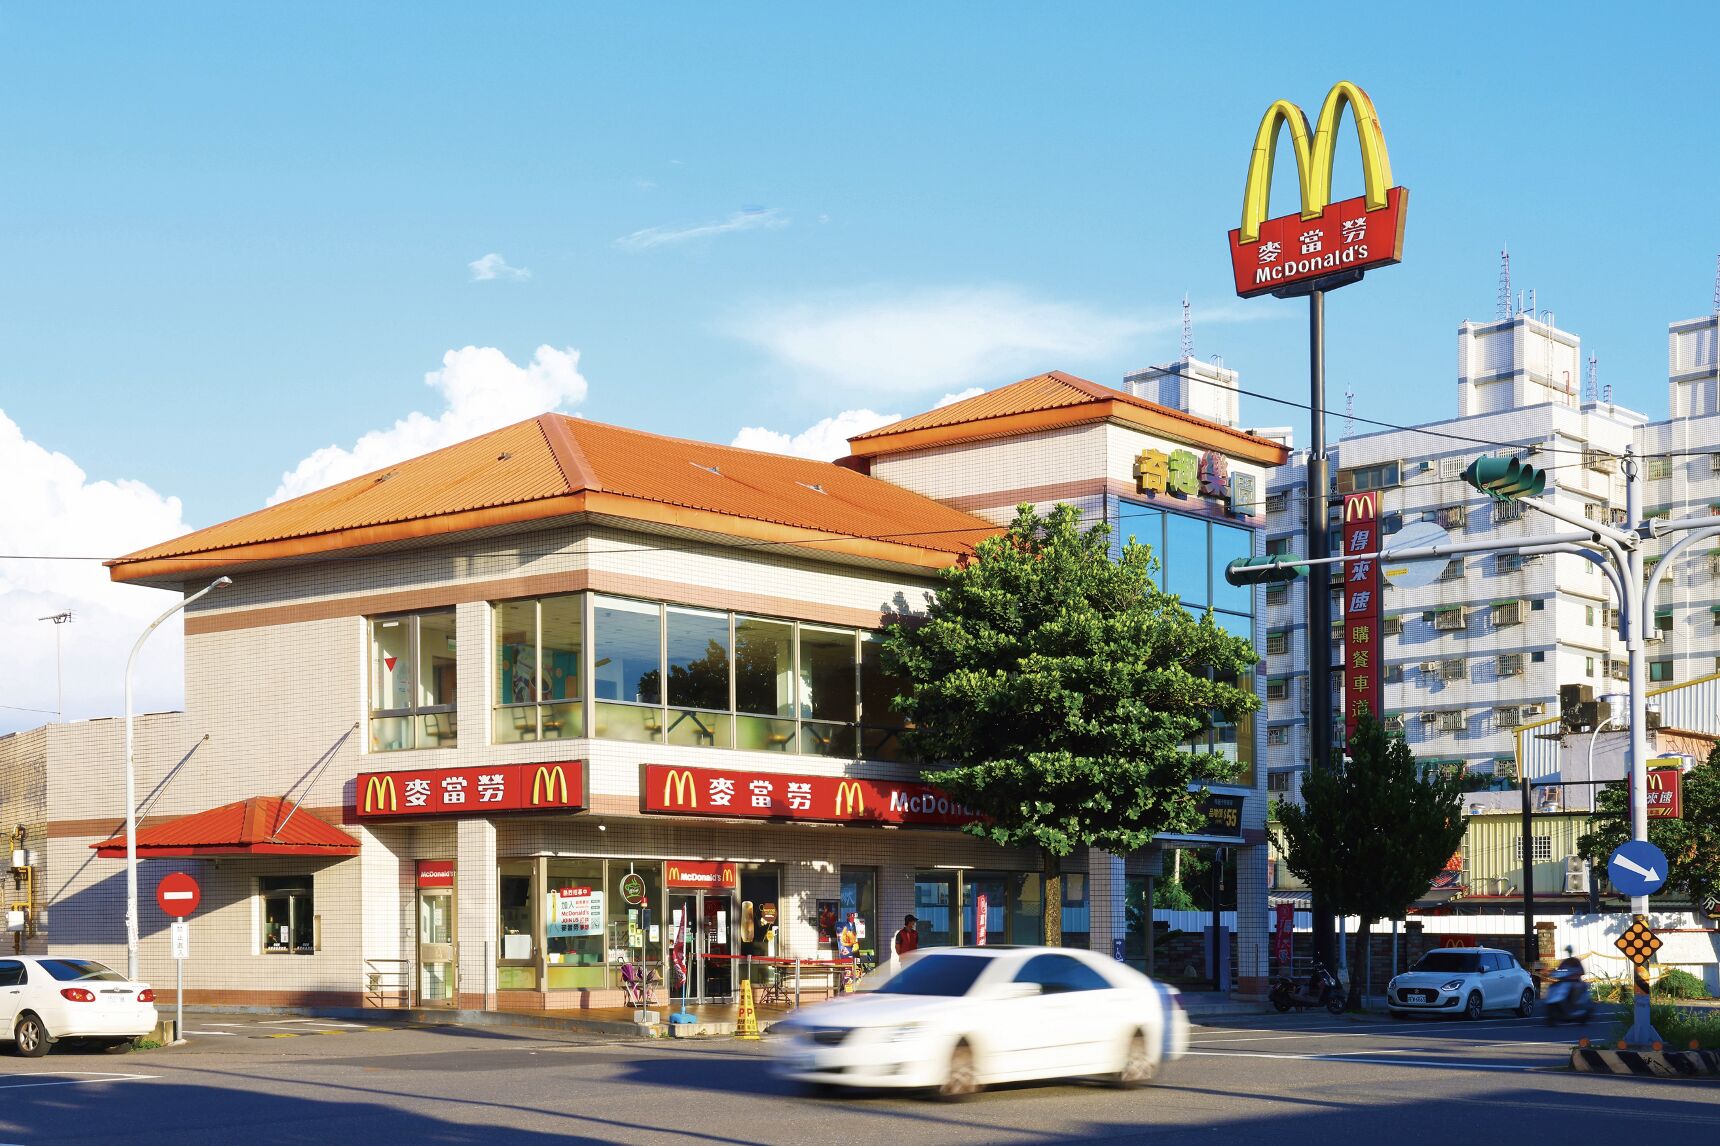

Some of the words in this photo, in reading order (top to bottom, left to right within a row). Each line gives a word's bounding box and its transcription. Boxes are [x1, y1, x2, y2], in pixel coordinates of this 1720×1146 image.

[1258, 216, 1367, 264] 麥當勞
[1255, 245, 1369, 284] McDonald's
[1349, 530, 1372, 613] 得來速
[404, 774, 505, 807] 麥當勞
[709, 777, 813, 811] 麥當勞
[680, 872, 721, 882] McDonald's
